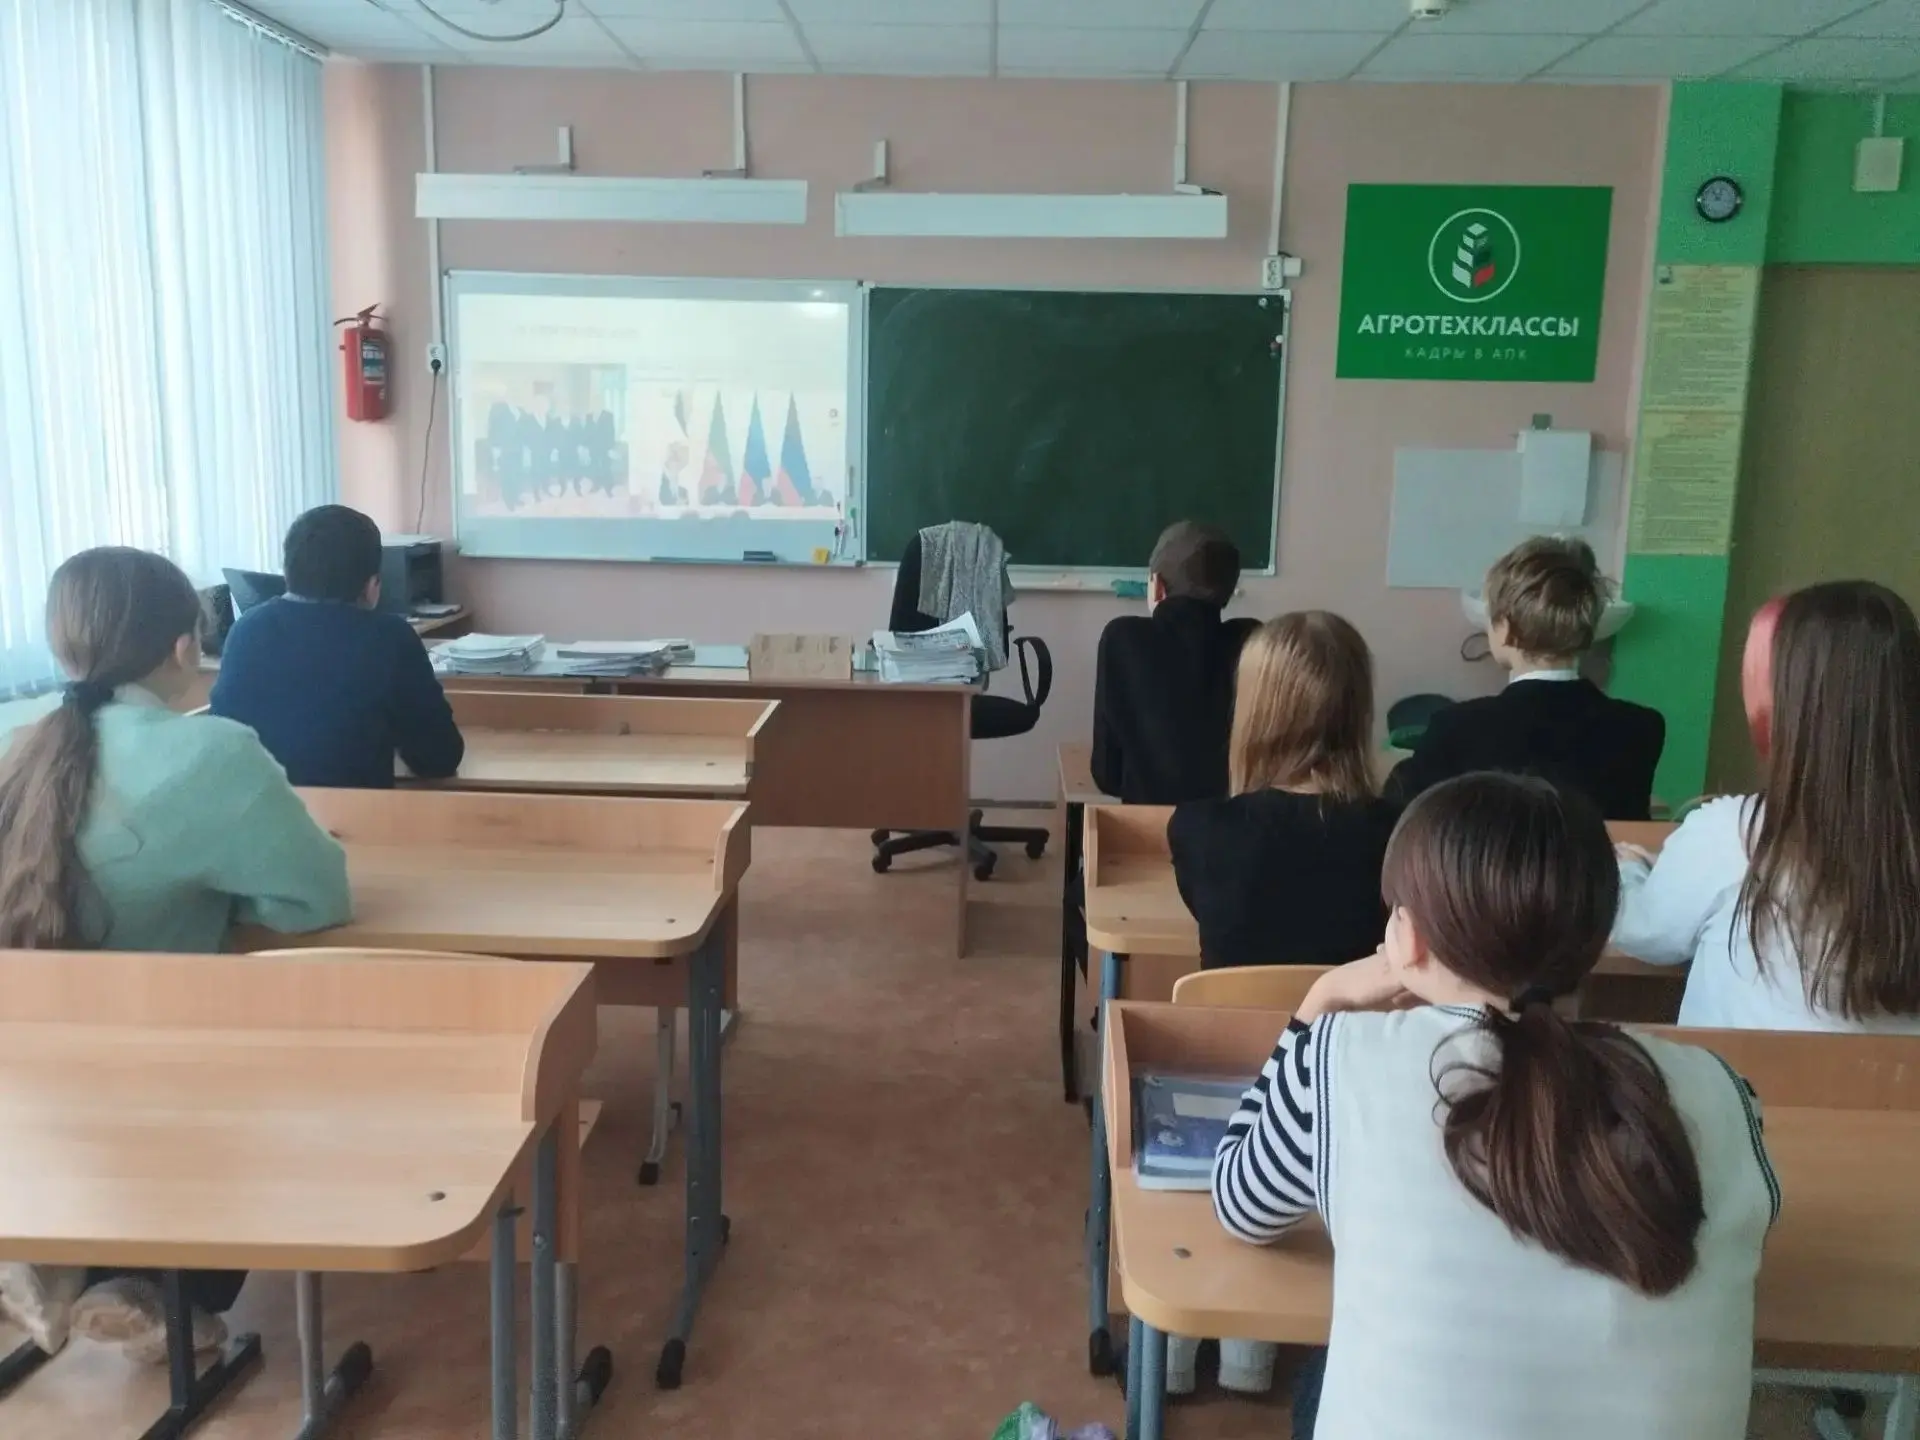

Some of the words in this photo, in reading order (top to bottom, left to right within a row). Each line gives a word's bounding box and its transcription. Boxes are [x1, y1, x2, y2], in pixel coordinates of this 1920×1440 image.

[1357, 314, 1579, 337] АГРОТЕХКЛАССЫ
[1404, 347, 1465, 360] КАДРЫ
[1474, 348, 1483, 360] В
[1492, 348, 1527, 360] АПК
